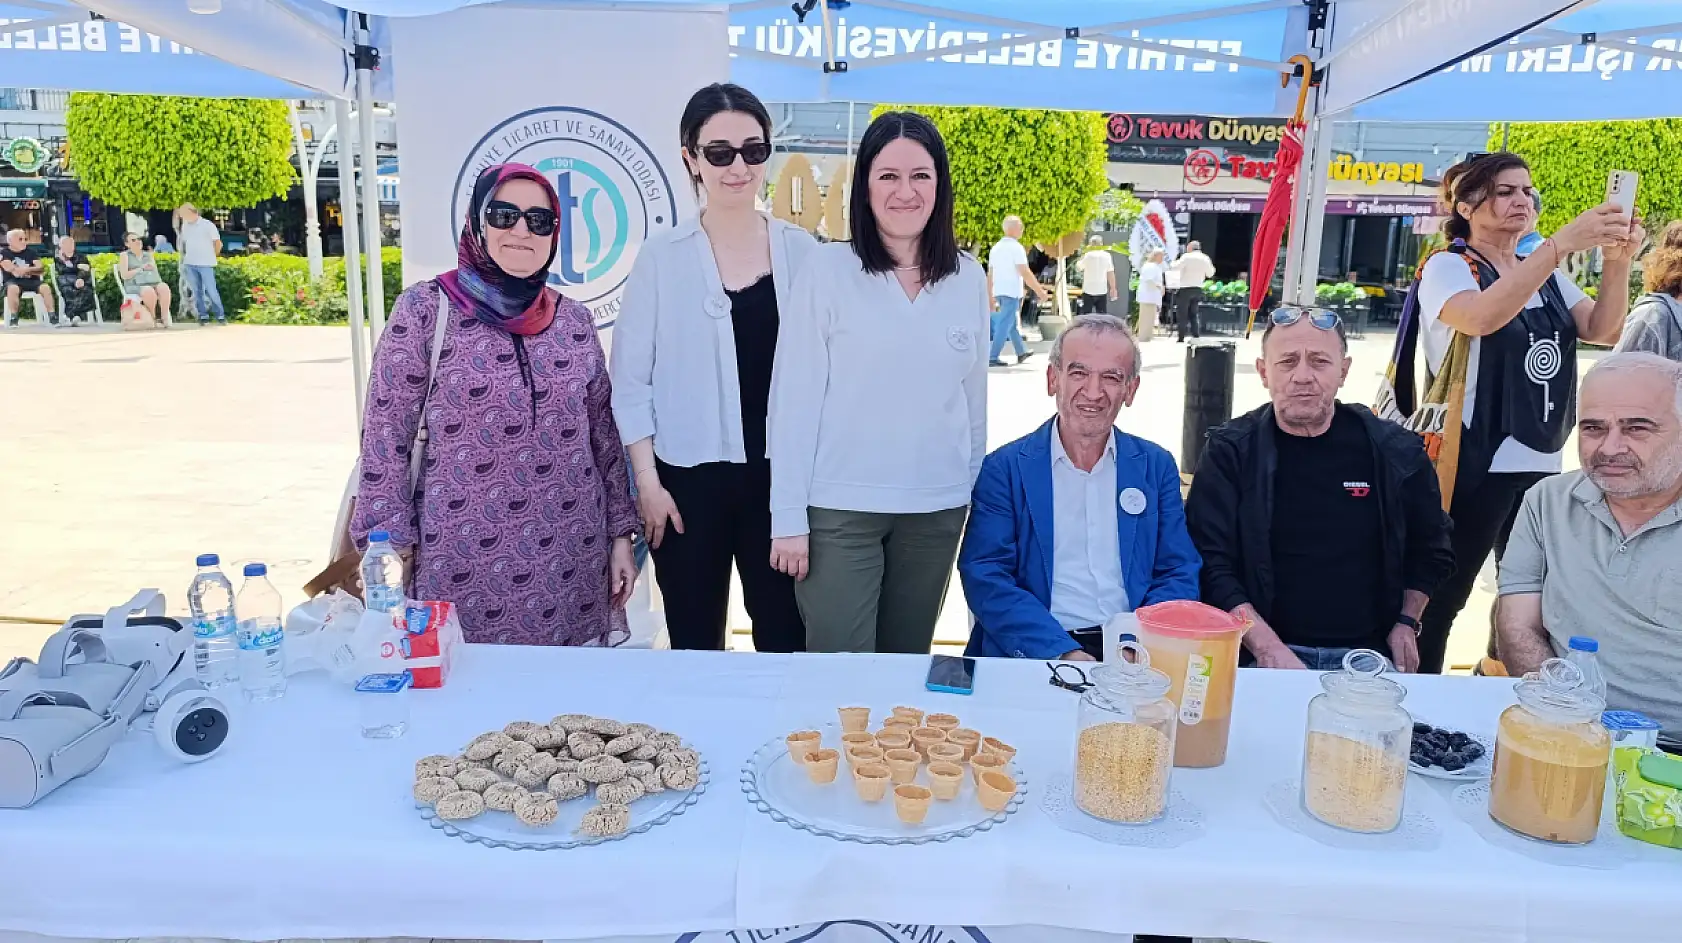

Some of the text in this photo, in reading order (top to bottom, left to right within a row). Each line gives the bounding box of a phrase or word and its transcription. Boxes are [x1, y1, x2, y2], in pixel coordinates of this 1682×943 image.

[566, 119, 583, 136] VE
[1137, 117, 1286, 145] Tavuk Dünyas
[1328, 154, 1424, 186] ünyası
